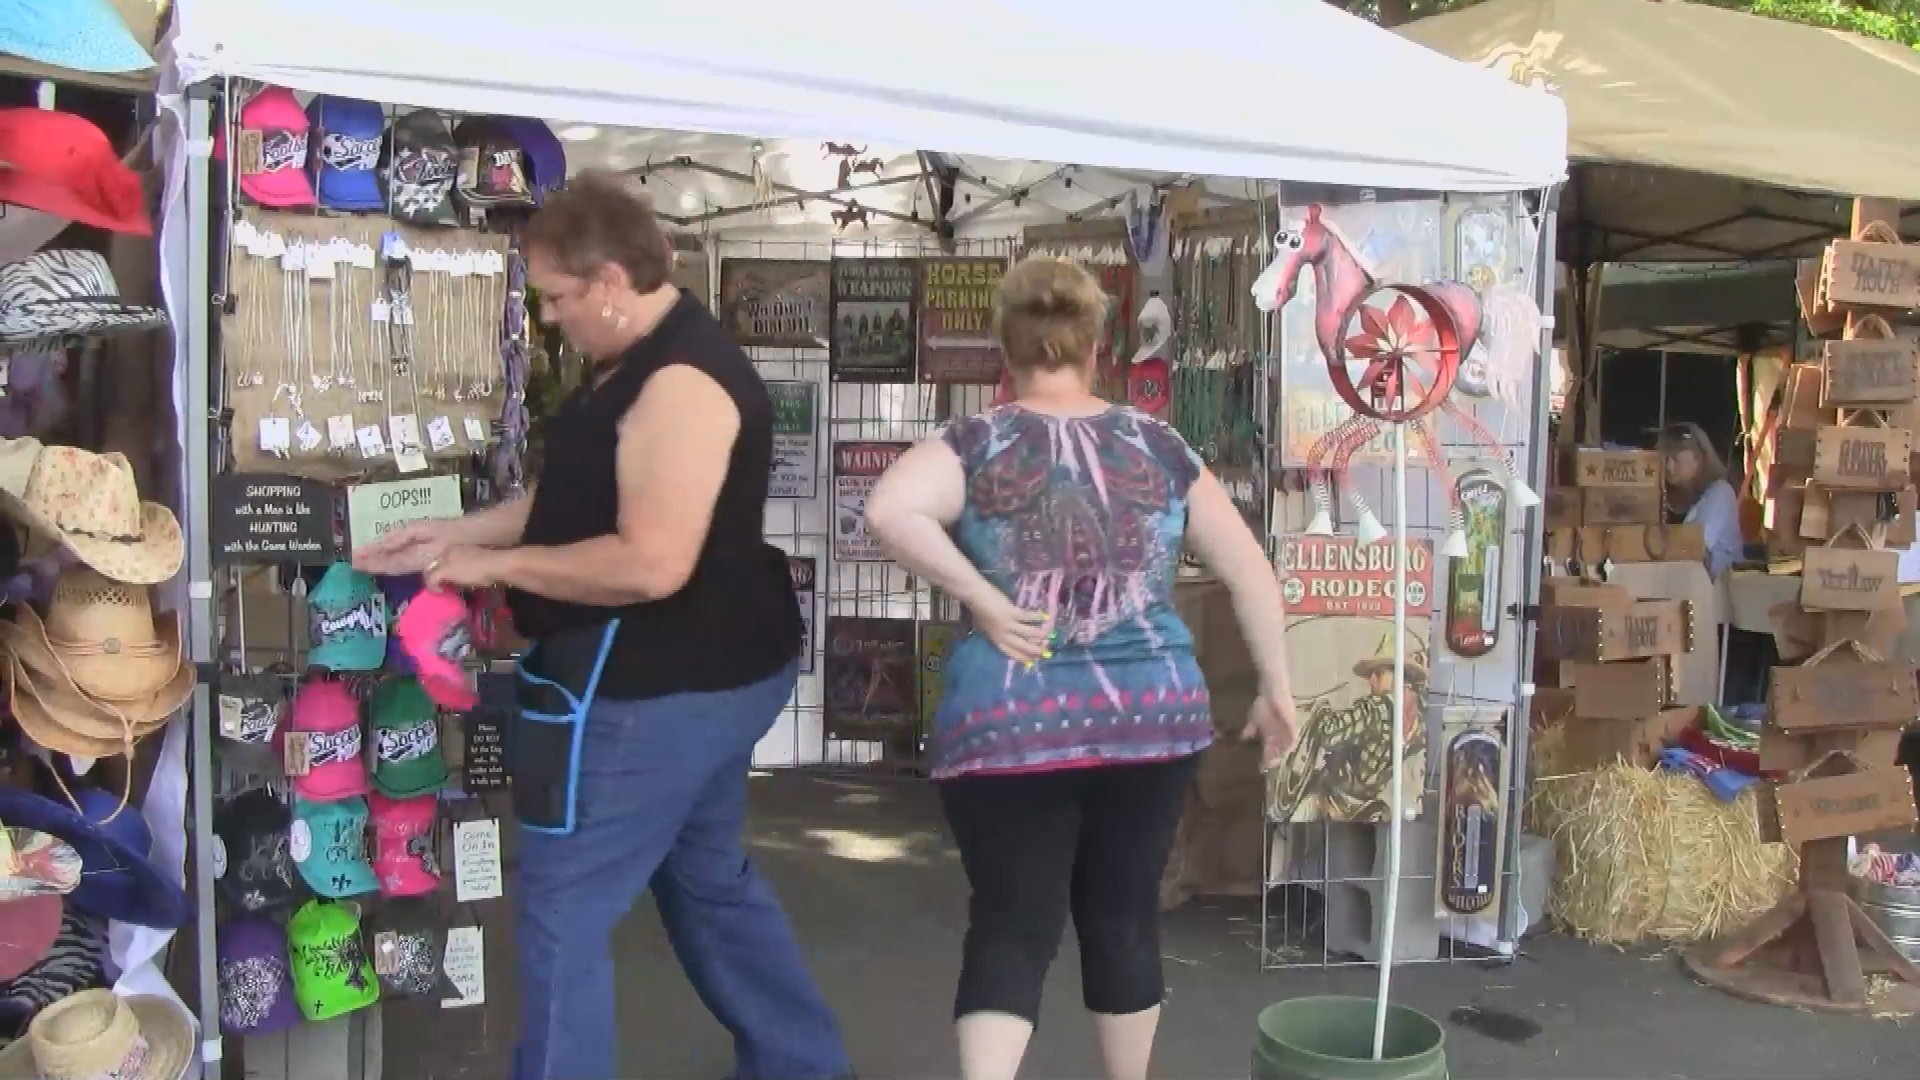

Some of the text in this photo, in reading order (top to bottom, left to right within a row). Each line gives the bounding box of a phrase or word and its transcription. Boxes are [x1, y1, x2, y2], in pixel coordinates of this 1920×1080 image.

[927, 264, 1001, 285] HORSE
[837, 280, 912, 297] WEAPONS
[926, 288, 991, 309] PARKIN
[942, 311, 984, 331] ONLY
[246, 485, 301, 497] SHOPPING
[380, 487, 431, 509] OOPS!!!
[235, 501, 312, 515] with a Man is like
[249, 521, 298, 533] HUNTING
[224, 537, 322, 553] with the Game Warden
[1310, 577, 1397, 599] RODEO
